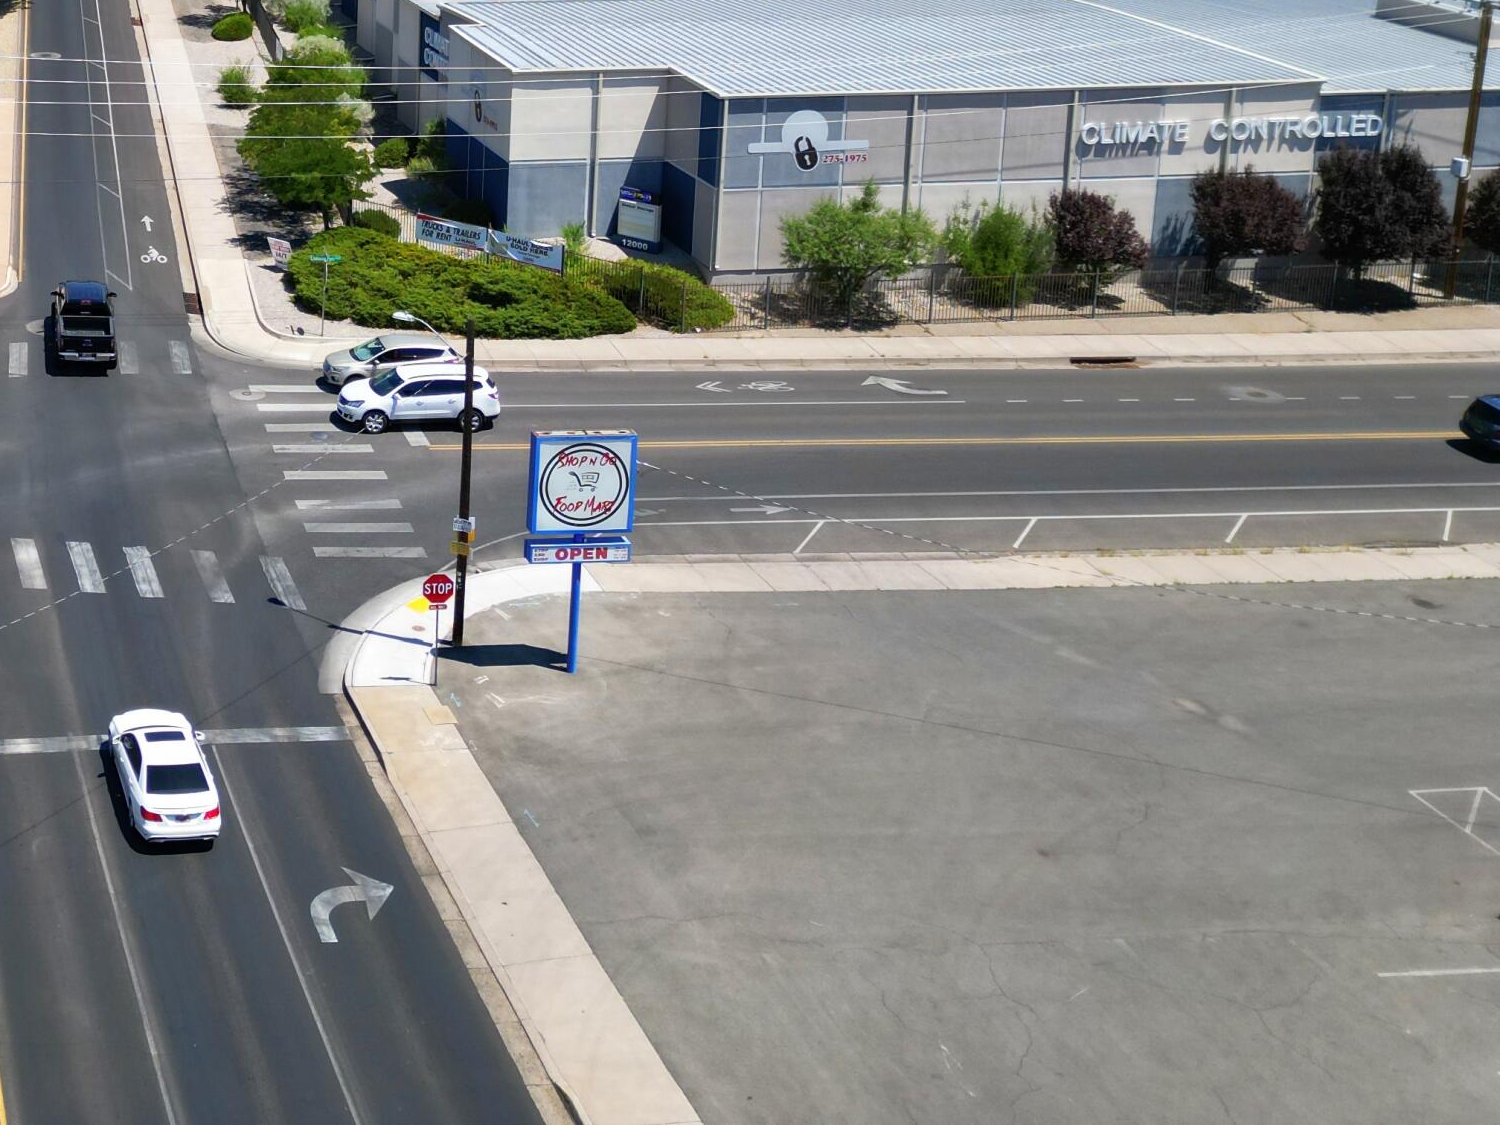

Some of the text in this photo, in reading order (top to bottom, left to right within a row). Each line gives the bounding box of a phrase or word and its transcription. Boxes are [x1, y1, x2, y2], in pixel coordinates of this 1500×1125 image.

[1082, 115, 1383, 145] CLIMATE CONTROLLED
[823, 154, 867, 163] 275-1975
[421, 220, 444, 232] TRUCKS
[453, 227, 481, 240] TRAILERS
[421, 228, 452, 242] FOR RENT
[506, 236, 530, 247] U-HAUL
[622, 238, 648, 250] 12000
[510, 242, 528, 252] SOLD
[530, 247, 548, 257] HERE
[557, 452, 588, 469] SHOP
[553, 495, 616, 516] FOOD MART
[555, 547, 608, 560] OPEN
[424, 583, 453, 594] STOP
